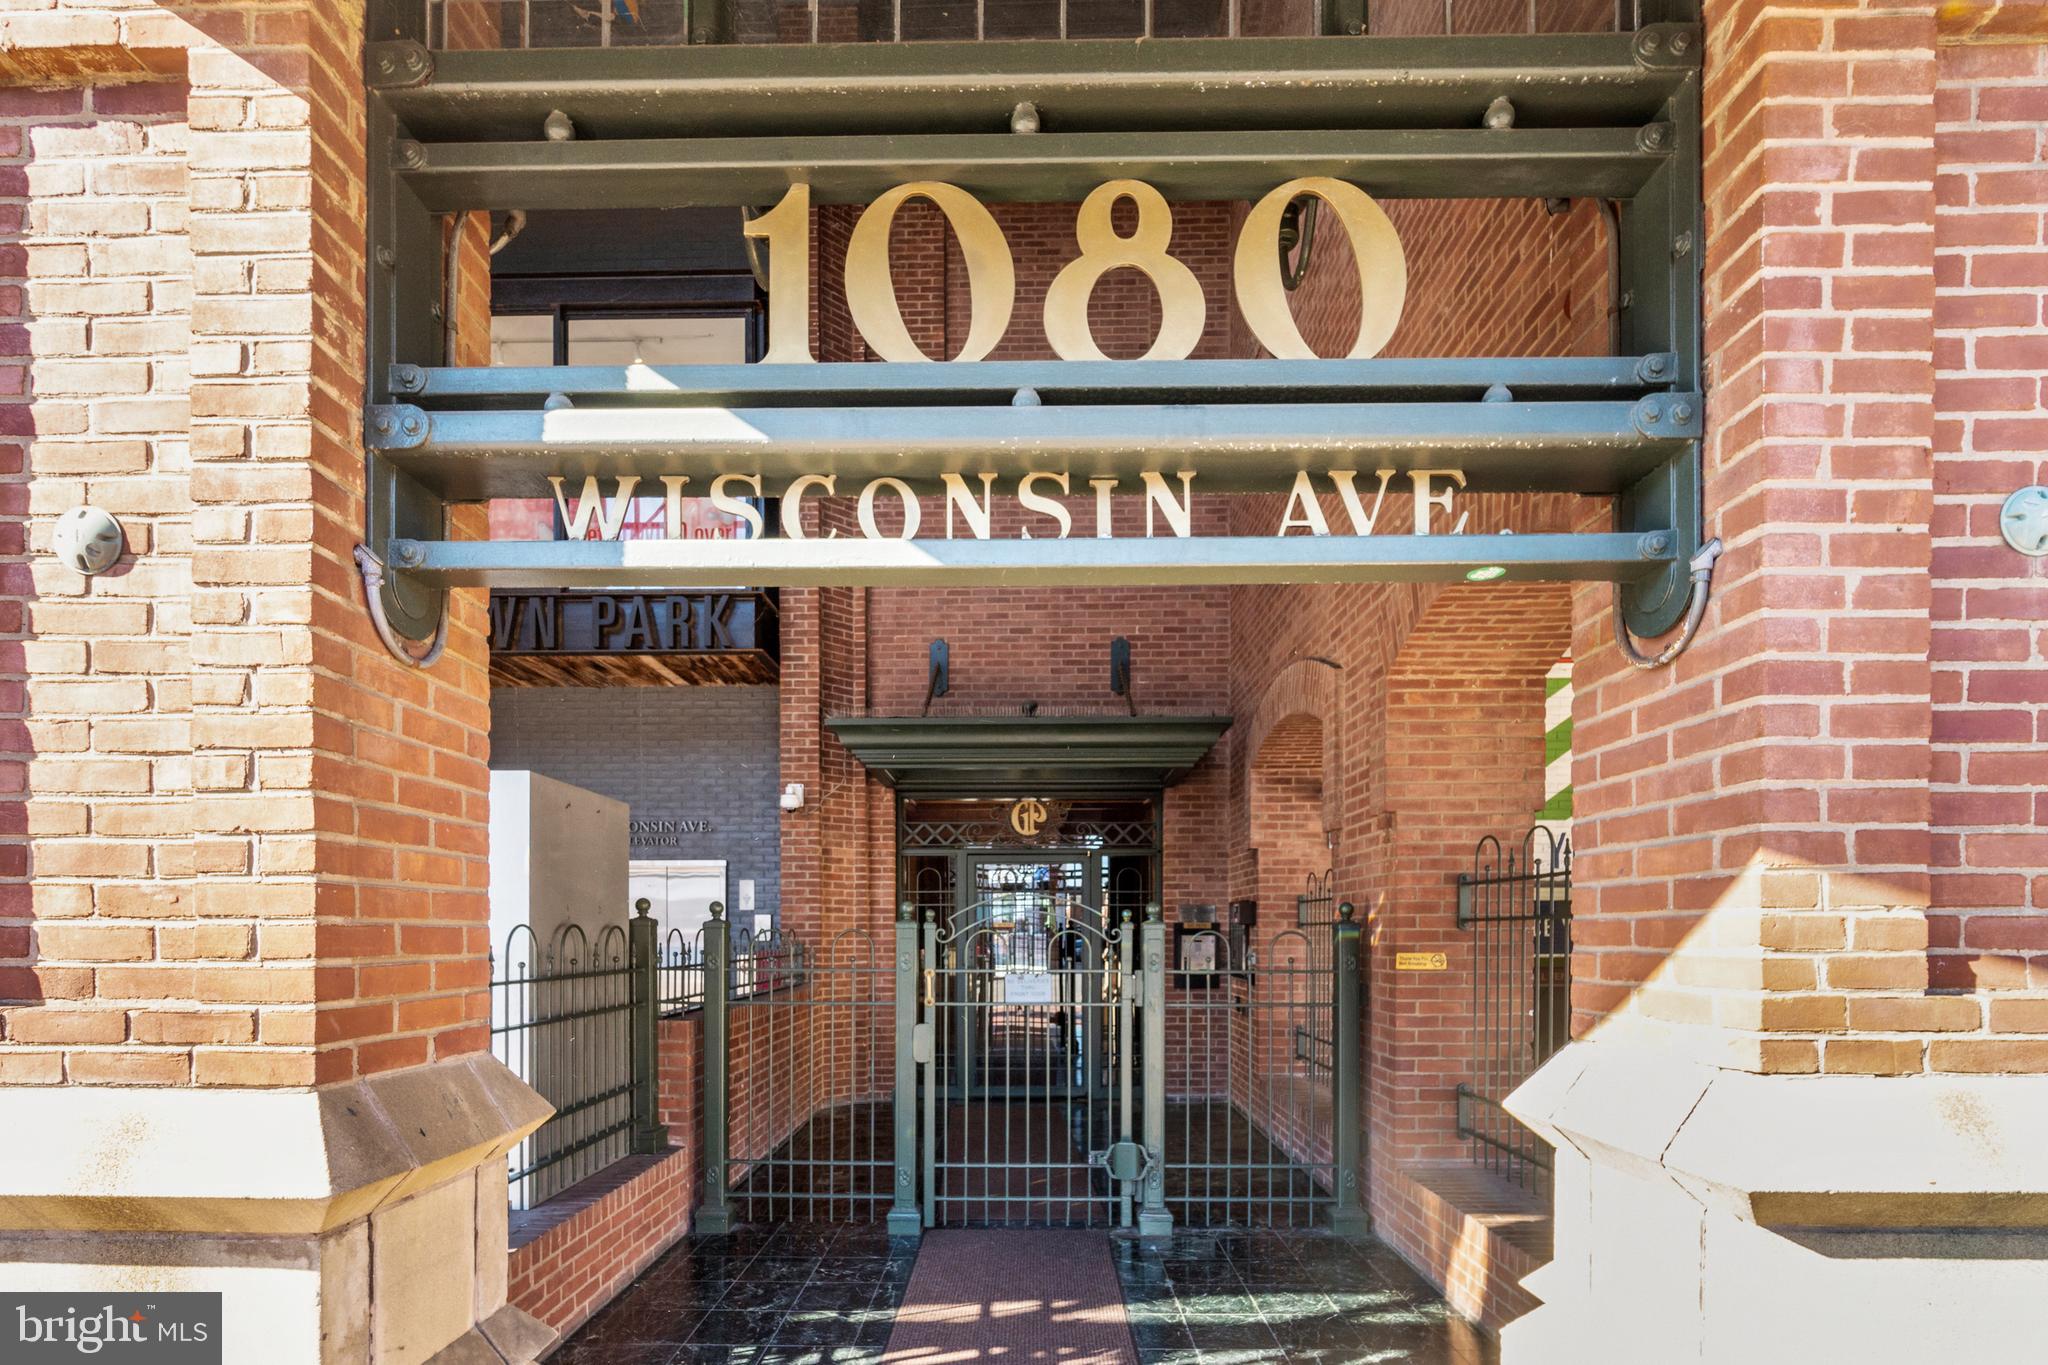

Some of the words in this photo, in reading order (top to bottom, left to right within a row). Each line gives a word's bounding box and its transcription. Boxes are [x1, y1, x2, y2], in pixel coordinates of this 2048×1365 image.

[743, 176, 1406, 363] 1080
[547, 470, 1197, 540] WISCONSIN
[1278, 469, 1469, 536] AVE
[592, 595, 734, 649] PARK
[680, 820, 712, 833] AVE.
